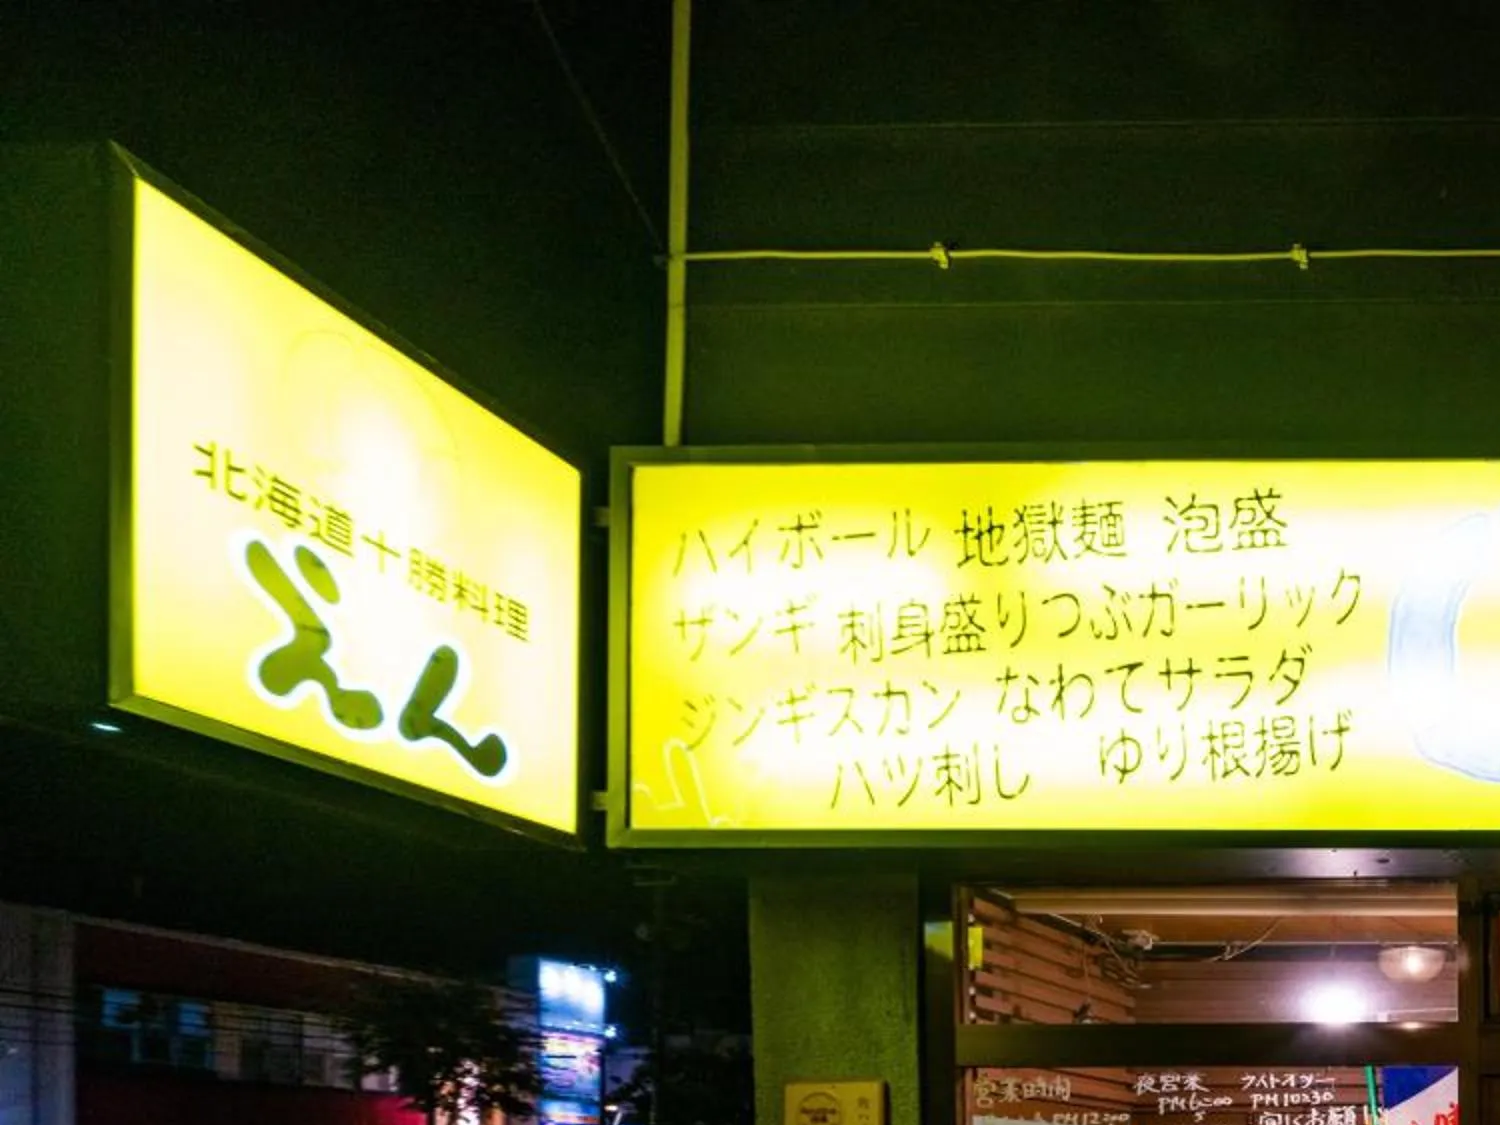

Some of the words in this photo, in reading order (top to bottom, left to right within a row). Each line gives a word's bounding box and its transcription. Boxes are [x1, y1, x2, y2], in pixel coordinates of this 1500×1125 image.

[193, 440, 530, 643] 北海道十勝料理
[673, 507, 930, 577] ハイボール
[953, 498, 1128, 568] 地獄麺
[1163, 487, 1290, 556] 泡盛
[244, 539, 508, 777] えん
[673, 594, 819, 662] ザンギ
[682, 680, 963, 751] ジンギスカン
[995, 644, 1314, 725] なわてサラダ
[831, 743, 1031, 811] ハツ刺し
[1099, 711, 1353, 784] ゆり根揚げ
